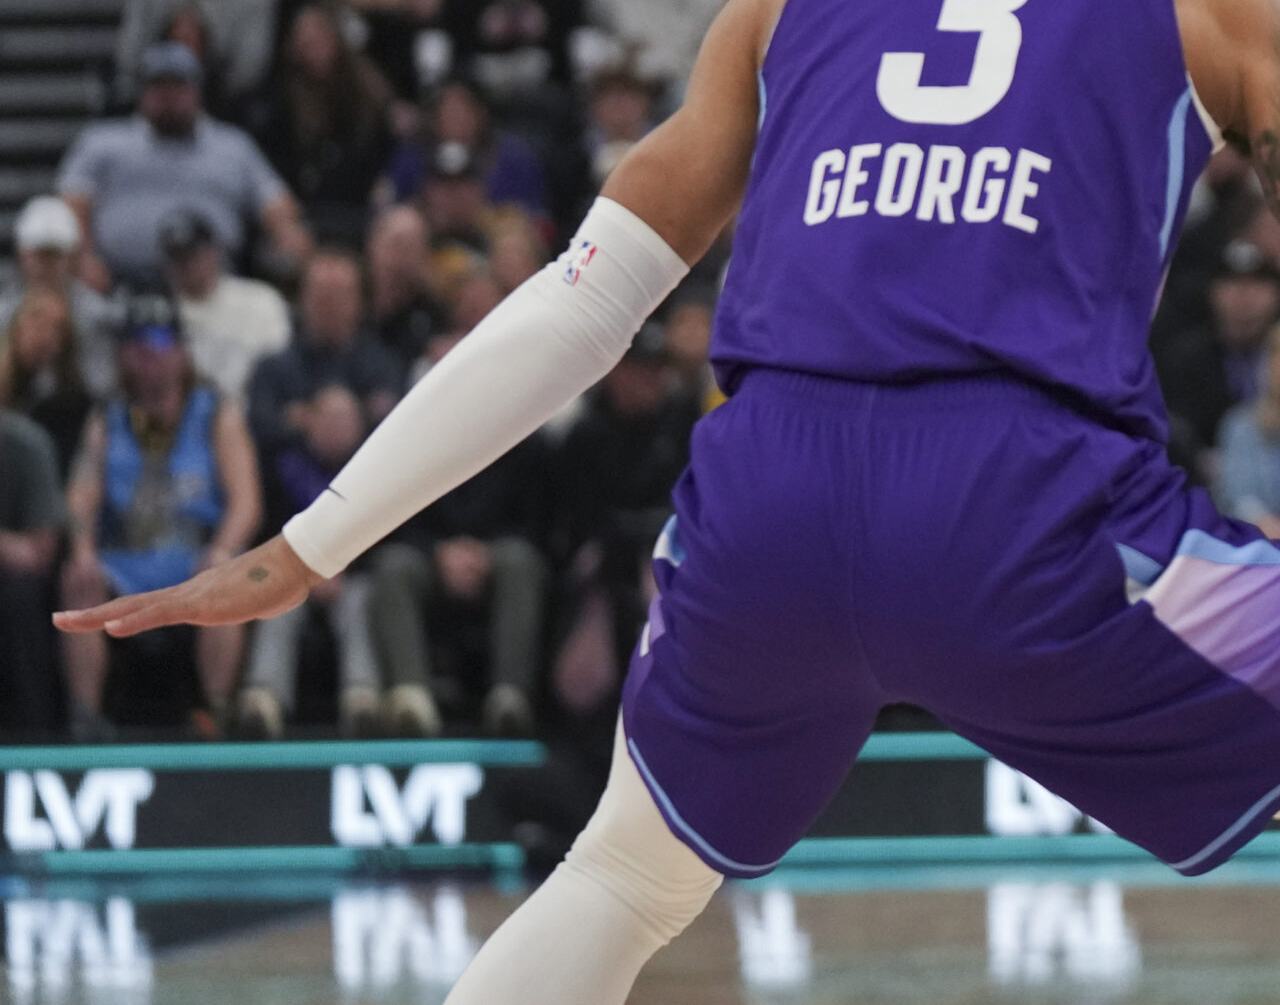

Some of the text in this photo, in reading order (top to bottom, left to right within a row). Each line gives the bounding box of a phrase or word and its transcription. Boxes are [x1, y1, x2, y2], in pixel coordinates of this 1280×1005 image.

[803, 142, 1052, 234] GEORGE
[5, 768, 155, 850] LVT
[331, 762, 483, 846] LVT
